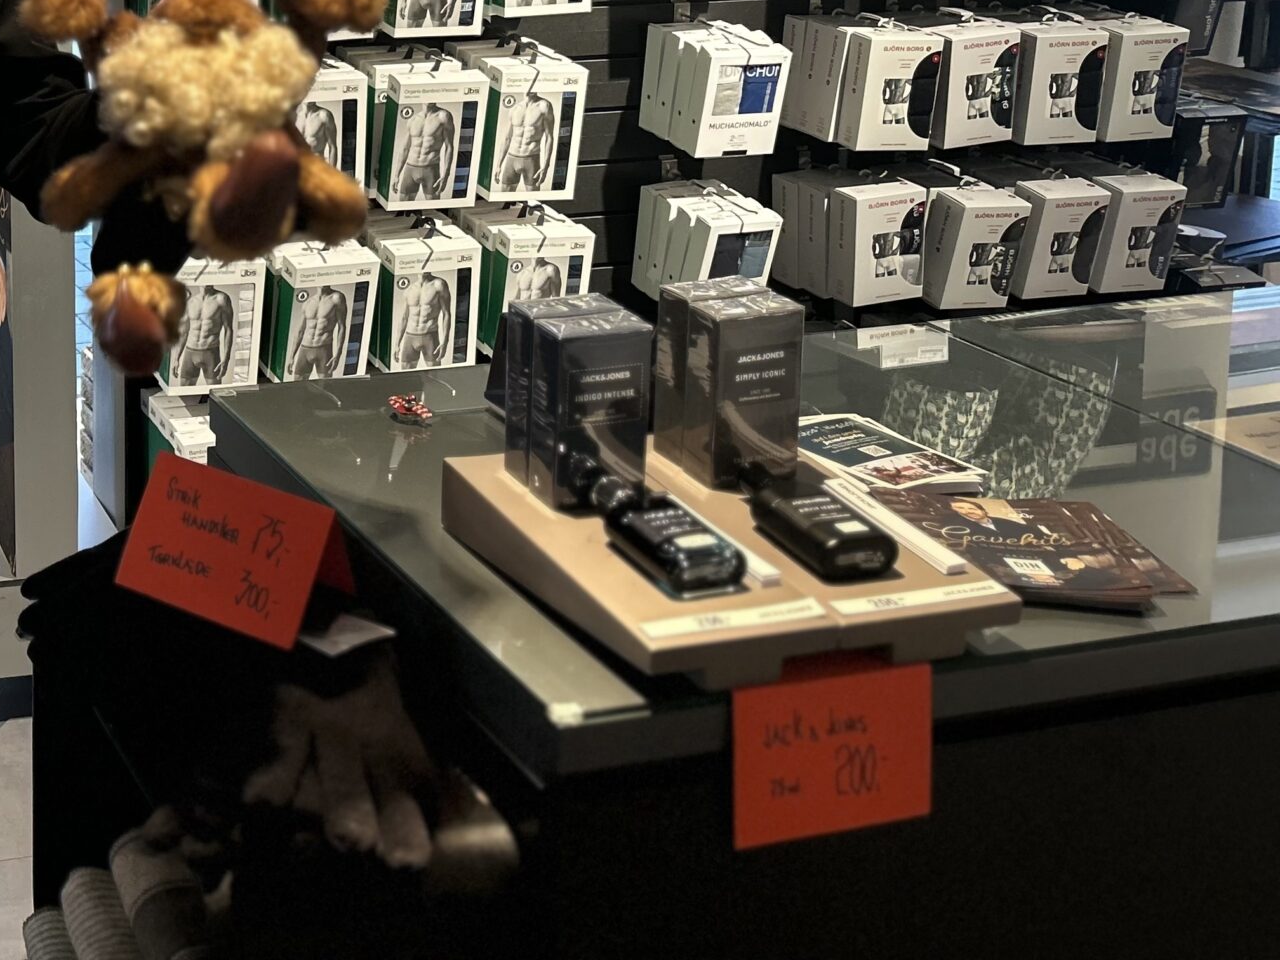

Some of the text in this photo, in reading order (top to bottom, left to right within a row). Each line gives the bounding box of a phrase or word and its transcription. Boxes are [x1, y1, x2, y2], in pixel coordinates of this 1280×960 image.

[709, 120, 769, 130] MUCHACHOMALO
[737, 350, 785, 363] JACK&JONES
[581, 370, 631, 383] JACK&JONES
[735, 368, 786, 382] SIMPLY ICONIC
[575, 388, 635, 403] INDIGO INTENSE
